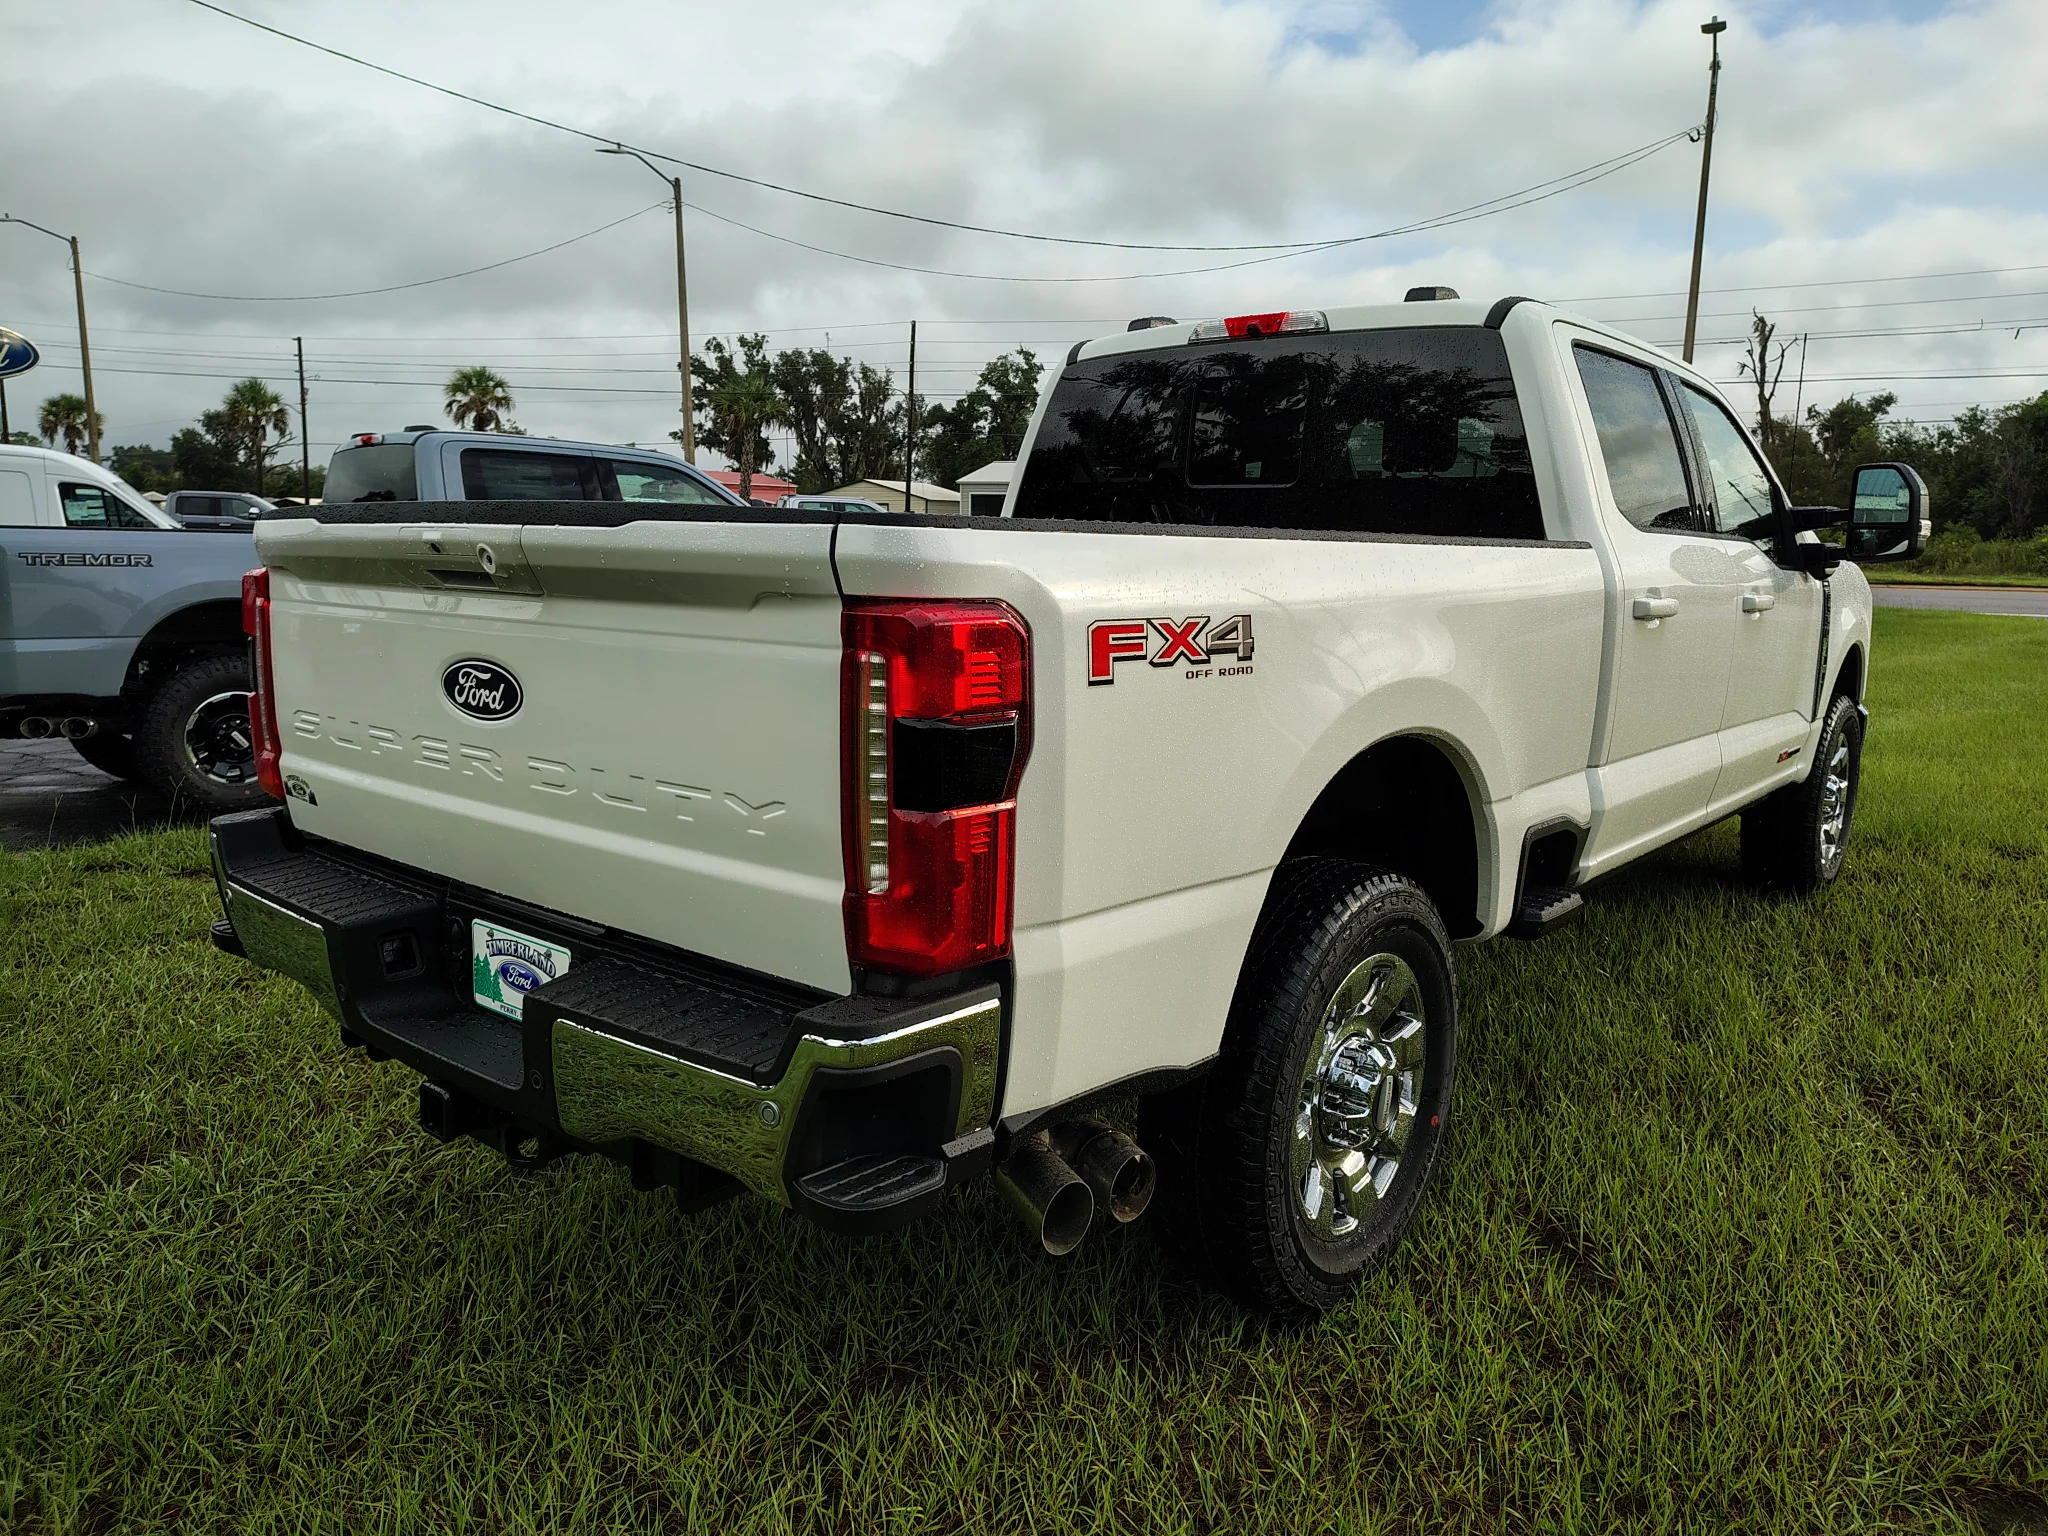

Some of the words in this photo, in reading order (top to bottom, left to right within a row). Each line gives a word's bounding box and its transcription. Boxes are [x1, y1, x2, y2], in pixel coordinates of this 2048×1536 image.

[18, 552, 154, 567] TREMOR
[1087, 614, 1254, 686] FX4
[454, 667, 505, 711] Ford
[1185, 668, 1213, 680] OFF
[1219, 666, 1254, 677] ROAD
[293, 709, 504, 782] SUPER
[527, 755, 786, 835] DUTY
[486, 938, 557, 978] TIMBERLAND
[506, 965, 533, 990] Ford
